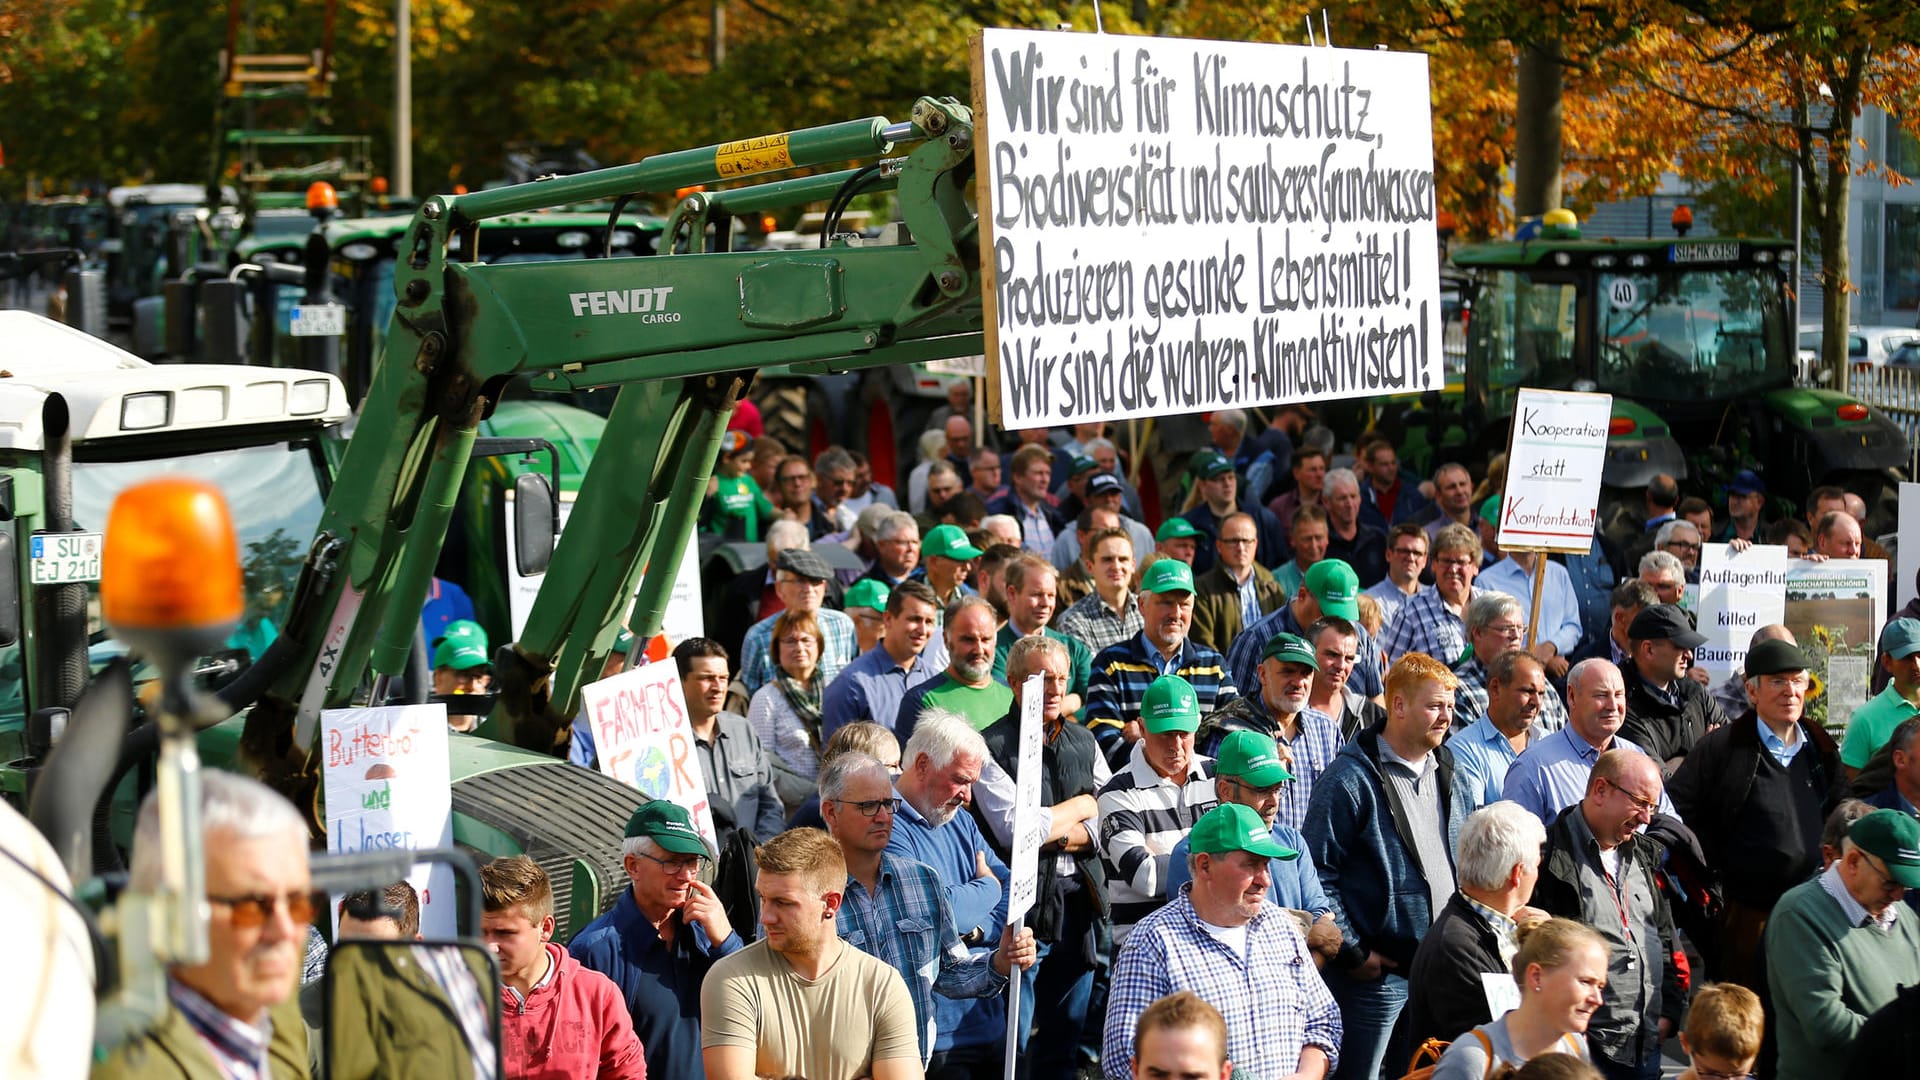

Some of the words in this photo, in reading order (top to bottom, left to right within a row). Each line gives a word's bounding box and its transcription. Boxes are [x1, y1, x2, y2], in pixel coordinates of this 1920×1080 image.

[992, 42, 1065, 134] Wir
[1066, 49, 1123, 134] sind
[1131, 48, 1176, 134] für
[995, 138, 1178, 230] Biodiversität
[1180, 142, 1222, 225] und
[1226, 143, 1318, 225] sauberes
[994, 235, 1134, 333] Produzieren
[1144, 238, 1249, 344] gesunde
[1257, 227, 1413, 314] Lebensmittel!
[1614, 283, 1632, 303] 40
[568, 286, 674, 316] FENDT
[641, 312, 682, 325] CARGO
[1001, 334, 1057, 419] Wir
[1060, 328, 1115, 418] sind
[1118, 329, 1156, 411] die
[1158, 318, 1249, 409] wahren
[1252, 299, 1431, 401] Klimaaktivisten!
[1521, 406, 1606, 441] Kooperation
[1531, 458, 1567, 477] statt
[1504, 495, 1596, 529] Konfrontation!
[57, 538, 81, 558] SU
[36, 561, 59, 581] EJ
[1701, 568, 1787, 588] Auflagenflut
[1717, 611, 1756, 626] killed
[596, 677, 684, 749] FARMERS
[361, 779, 391, 810] und
